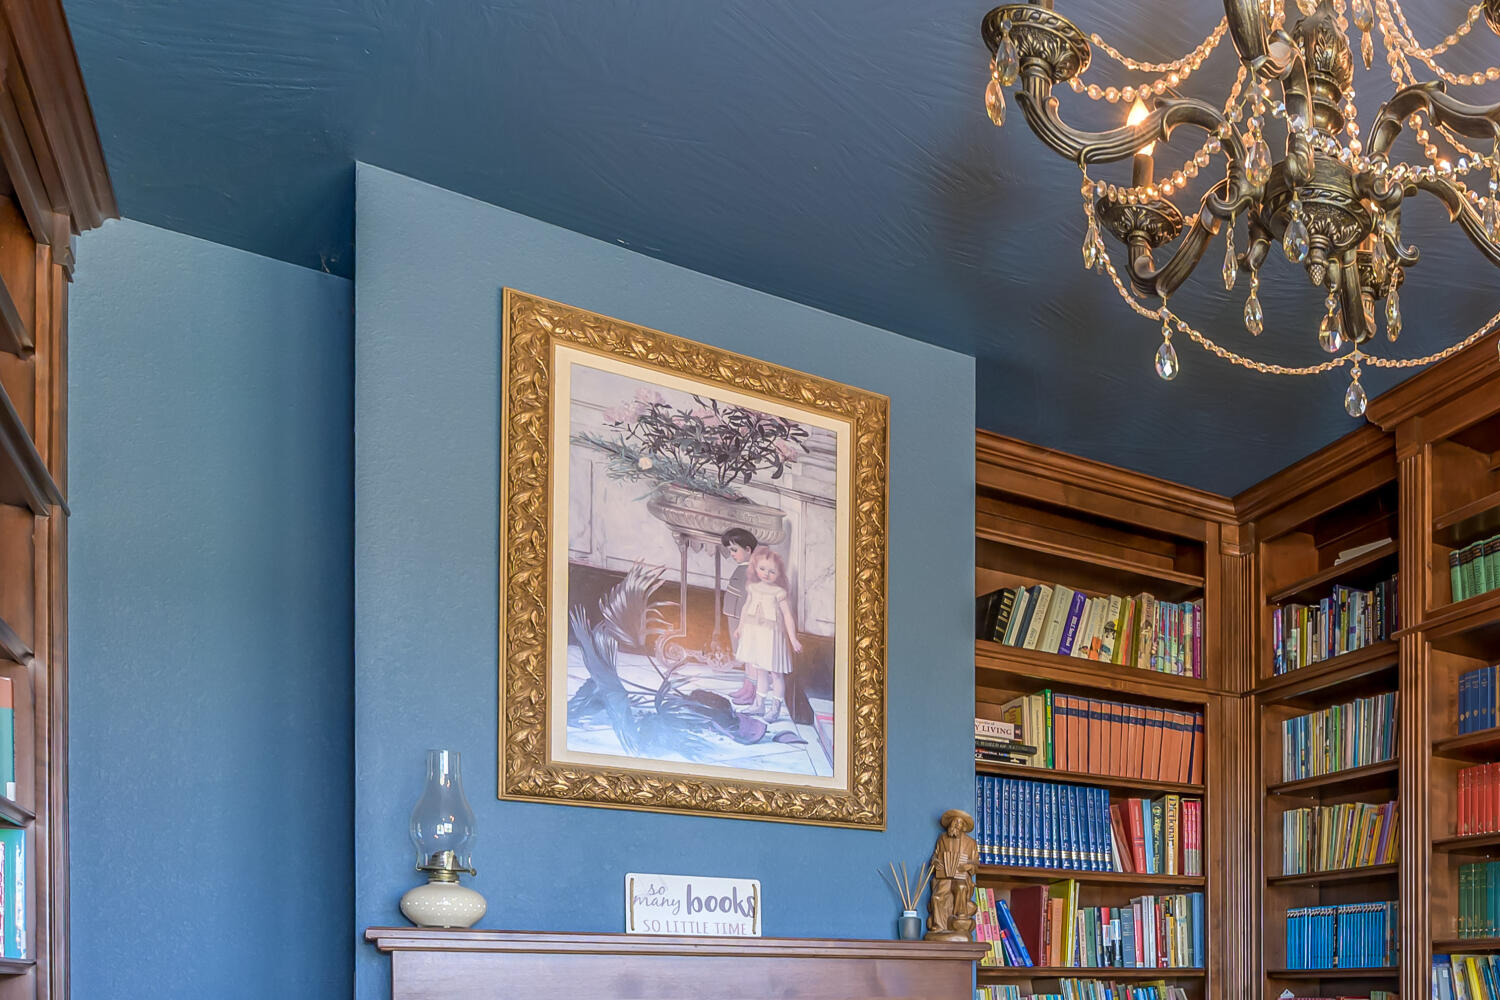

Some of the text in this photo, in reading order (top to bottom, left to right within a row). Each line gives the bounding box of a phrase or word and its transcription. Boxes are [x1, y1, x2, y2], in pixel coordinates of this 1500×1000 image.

[982, 725, 1012, 735] LIVING
[633, 884, 756, 918] so many books
[643, 919, 747, 936] SO LITTLE TIME
